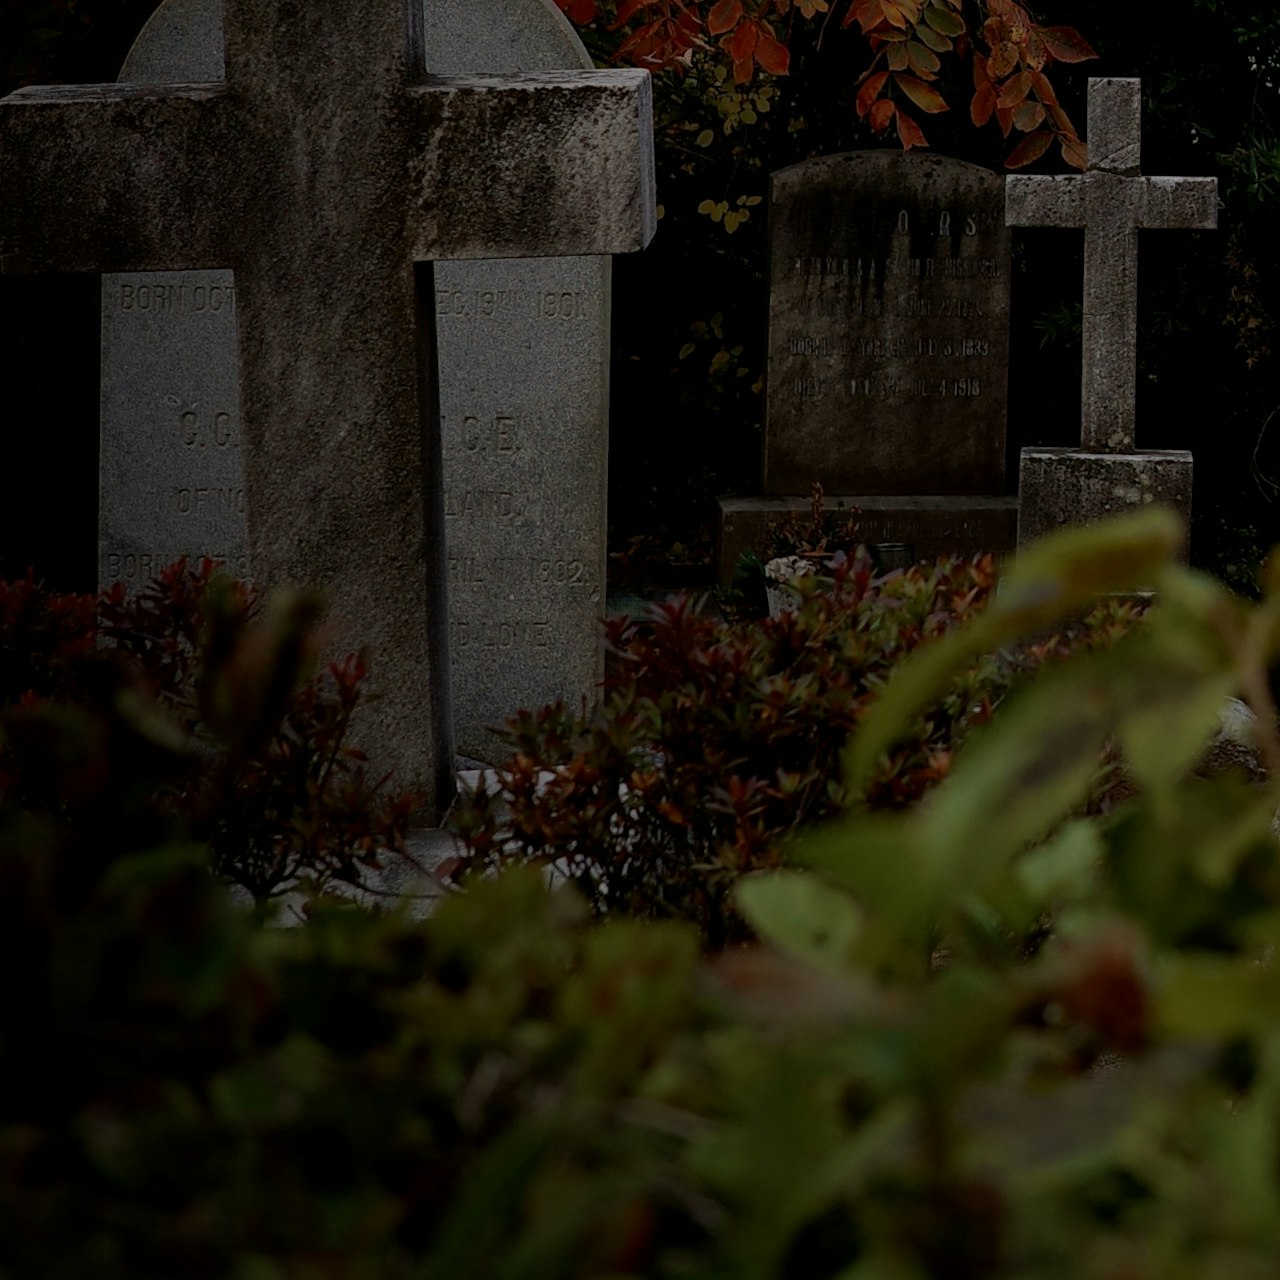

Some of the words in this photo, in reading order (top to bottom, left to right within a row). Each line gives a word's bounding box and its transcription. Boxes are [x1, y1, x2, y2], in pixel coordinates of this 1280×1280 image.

[120, 284, 187, 312] BORN
[436, 290, 469, 317] EC.
[953, 377, 981, 396] 1918
[177, 488, 208, 515] OF
